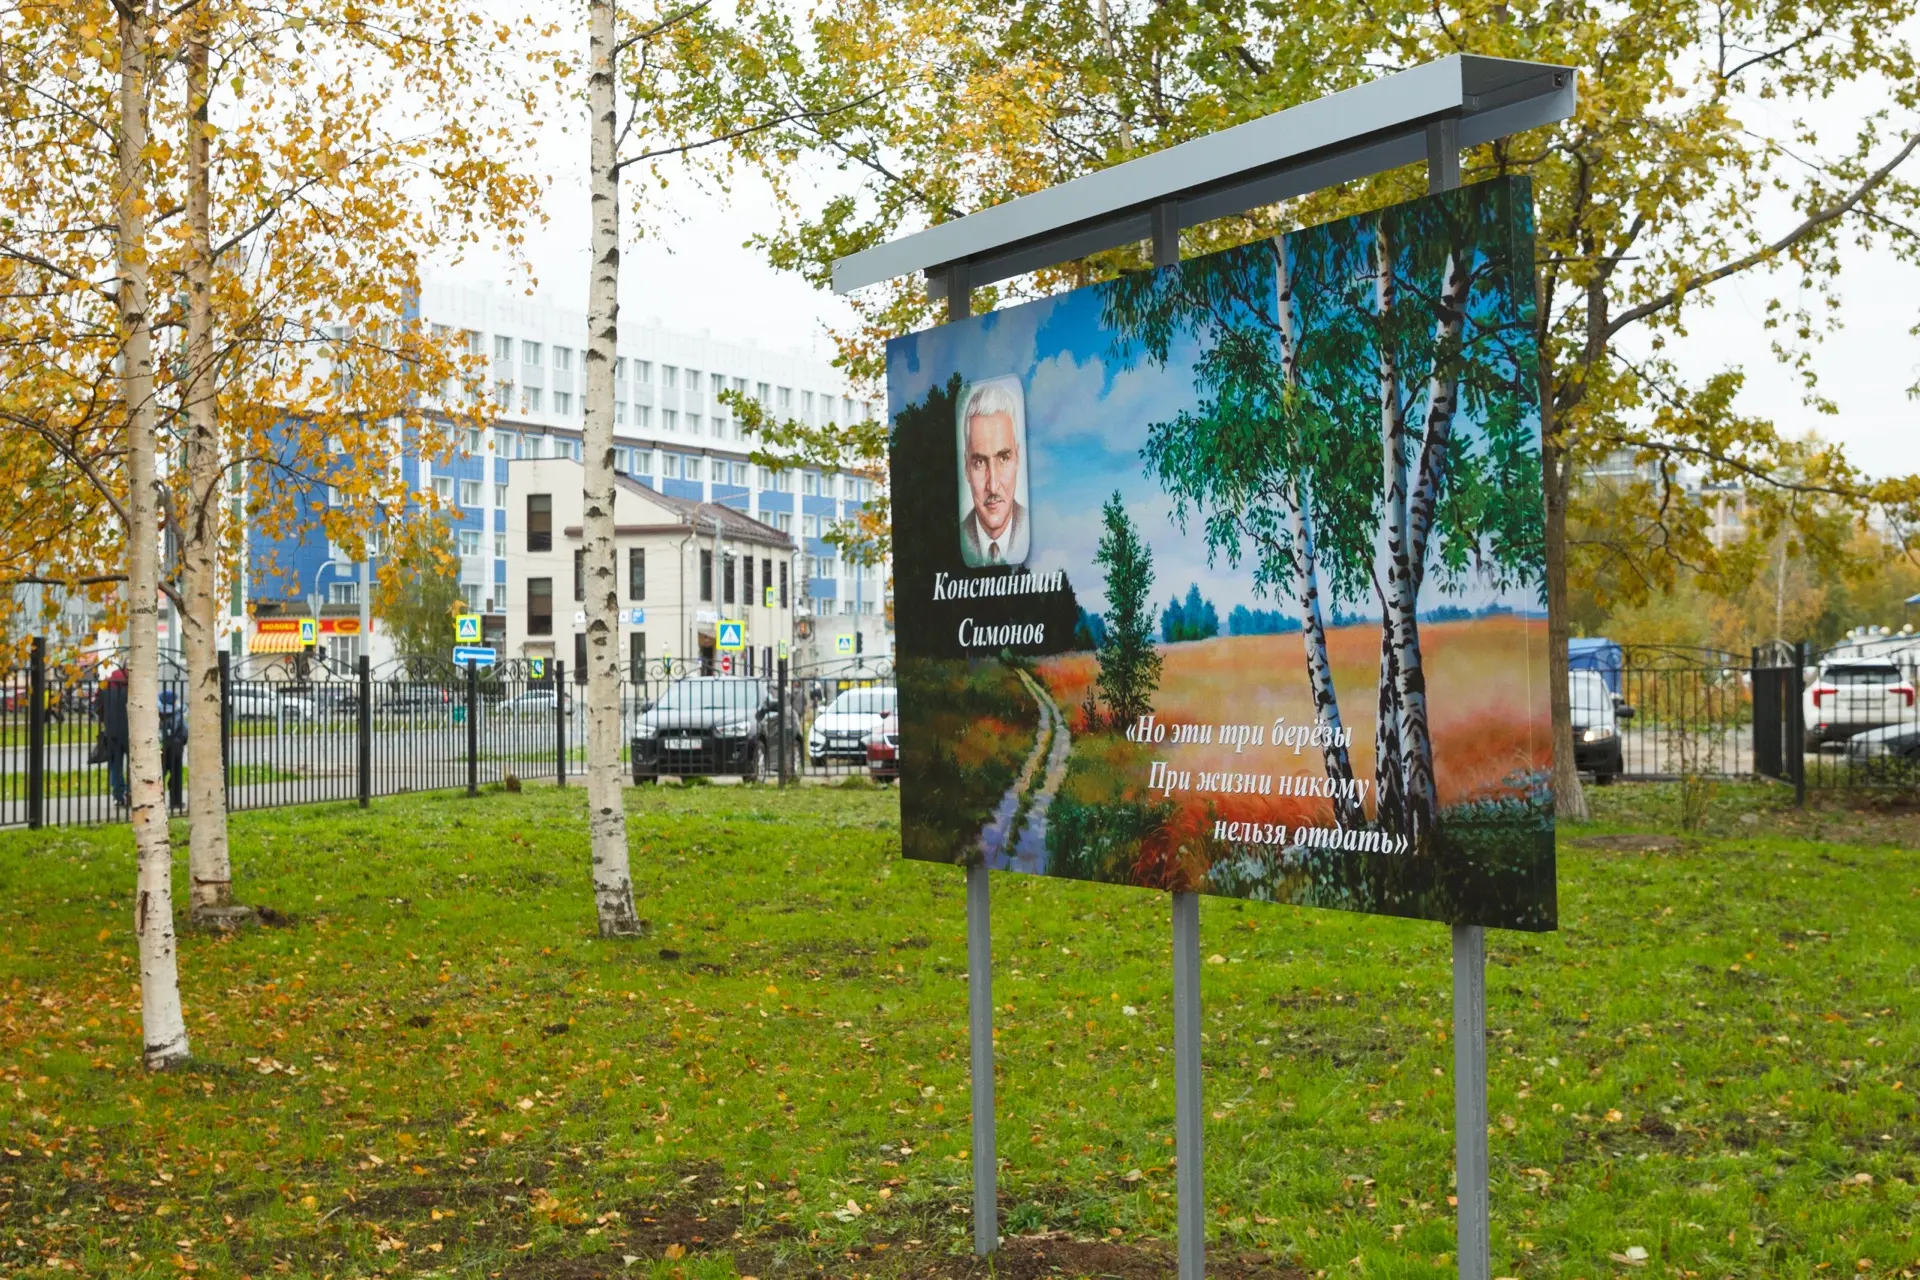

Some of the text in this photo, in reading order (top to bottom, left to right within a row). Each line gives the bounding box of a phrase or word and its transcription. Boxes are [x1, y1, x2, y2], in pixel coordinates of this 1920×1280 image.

[932, 571, 1063, 601] Константин
[958, 617, 1044, 647] Симонов
[1125, 715, 1353, 755] «Но эти три берёзы
[1148, 761, 1369, 808] При жизни никому
[1213, 820, 1409, 855] нельзя отдать»
